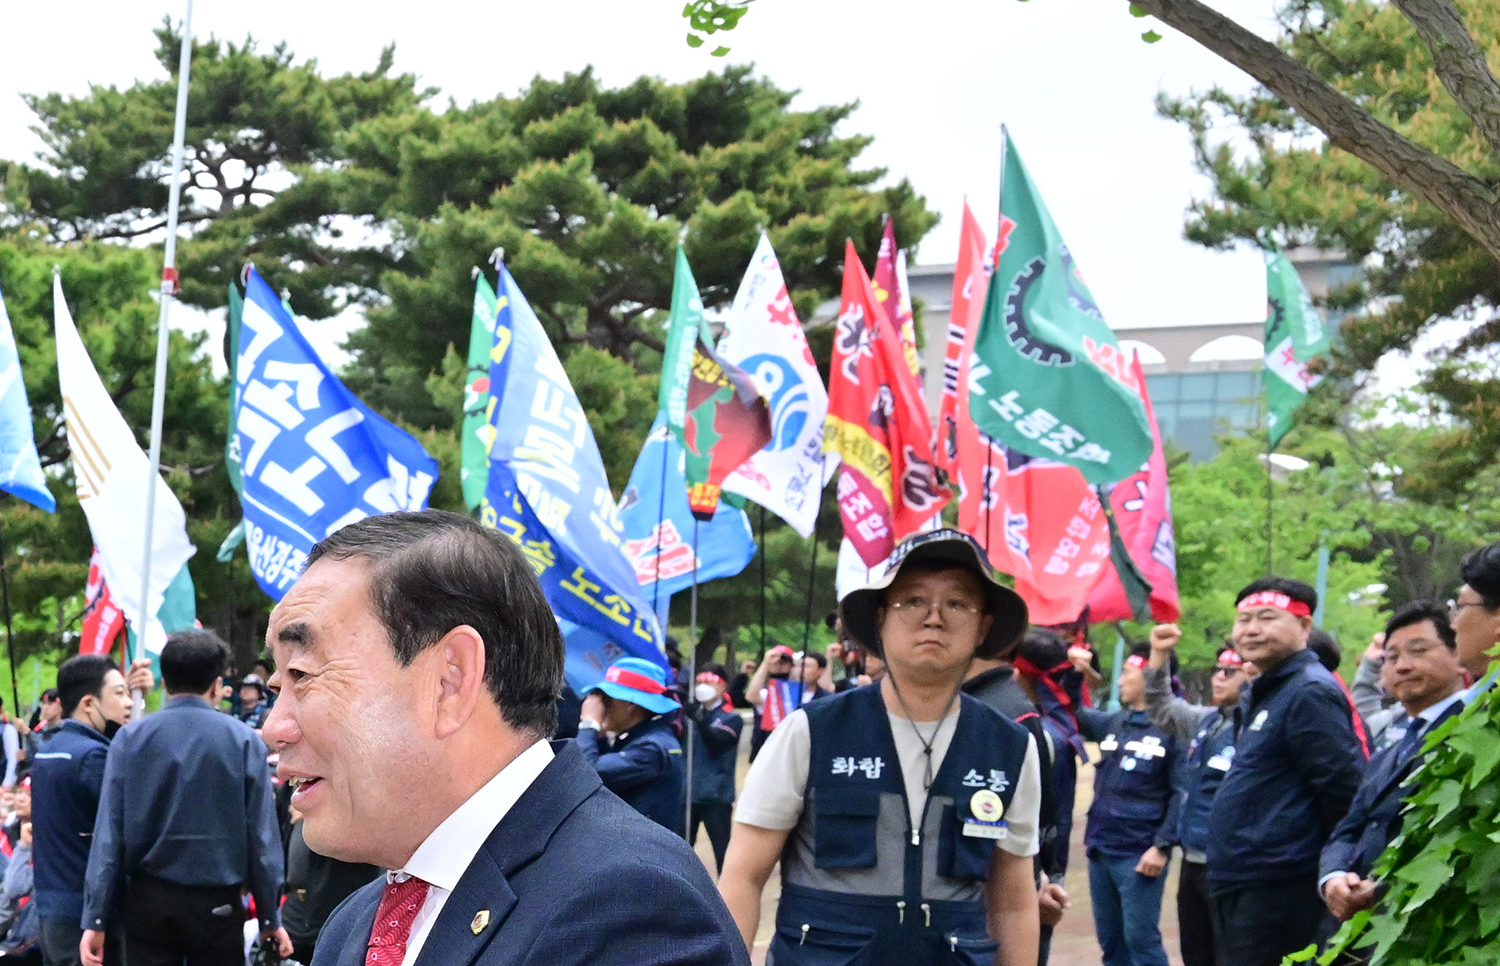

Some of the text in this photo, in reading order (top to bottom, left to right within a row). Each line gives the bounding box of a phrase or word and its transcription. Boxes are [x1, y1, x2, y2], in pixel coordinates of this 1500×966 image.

[988, 390, 1111, 465] 노동조합
[831, 757, 886, 779] 화합
[962, 768, 1010, 792] 소통
